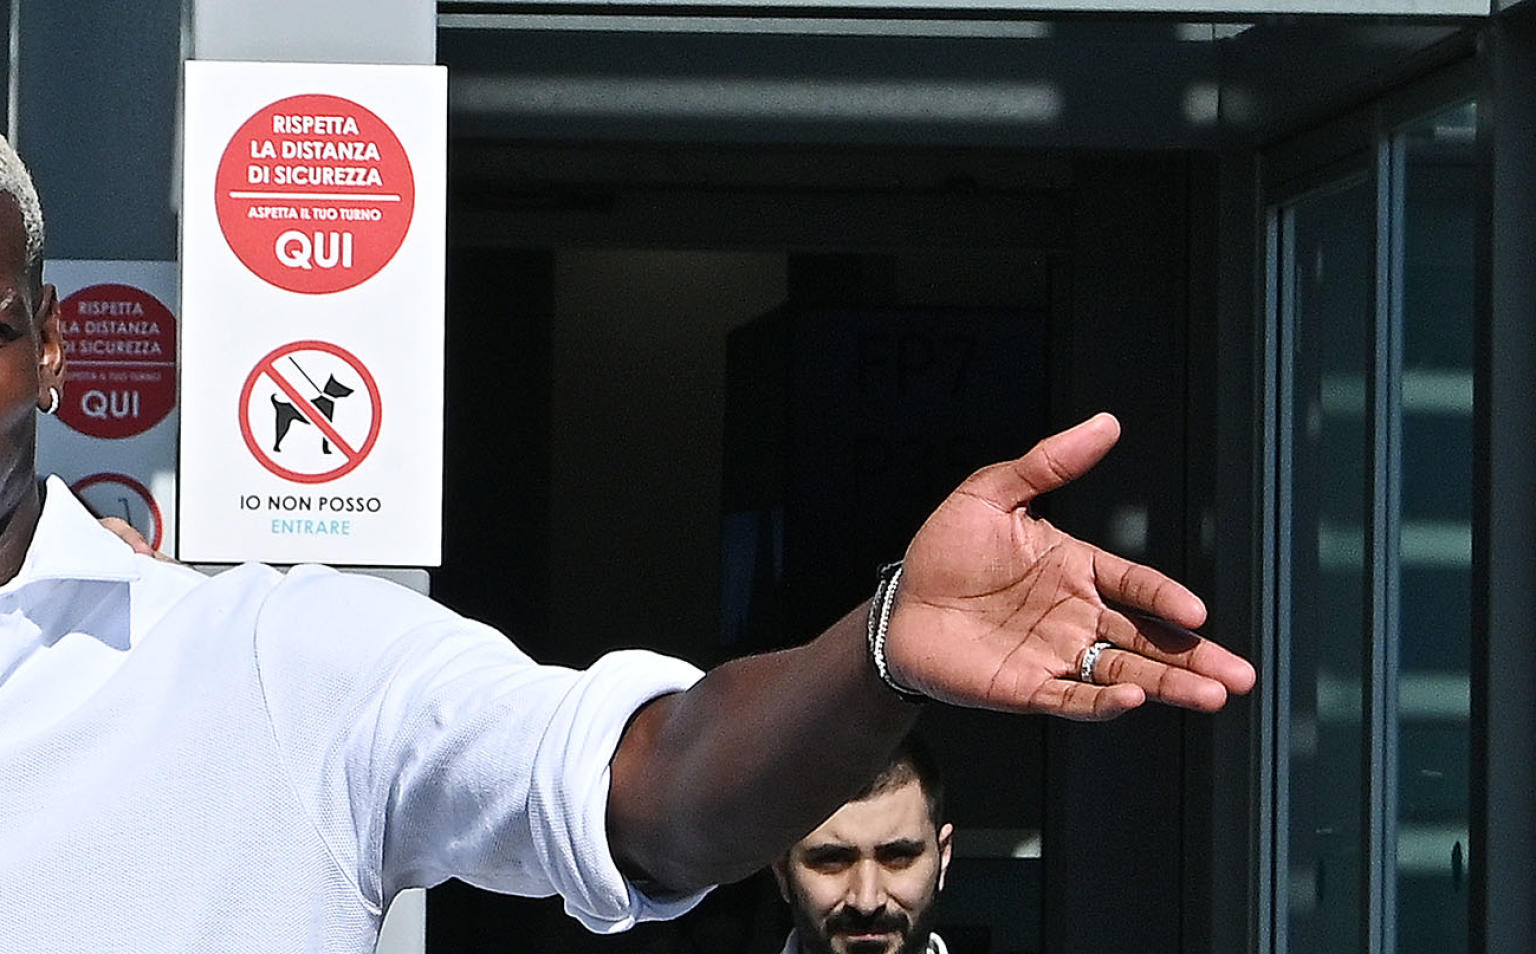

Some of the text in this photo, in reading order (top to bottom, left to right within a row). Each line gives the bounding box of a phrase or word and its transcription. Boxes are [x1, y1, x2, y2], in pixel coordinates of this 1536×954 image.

[273, 115, 359, 135] RISPETTA
[251, 140, 380, 161] LA DISTANZA
[248, 166, 383, 186] DI SICUREZZA
[248, 206, 383, 221] ASPETTA IL TUO TURNO
[275, 230, 352, 270] QUI
[78, 301, 144, 315] RISPETTA
[85, 320, 160, 335] DISTANZA
[80, 340, 162, 355] SICUREZZA
[81, 390, 141, 419] QUI
[240, 494, 381, 513] IO NON POSSO
[271, 519, 350, 535] ENTRARE
